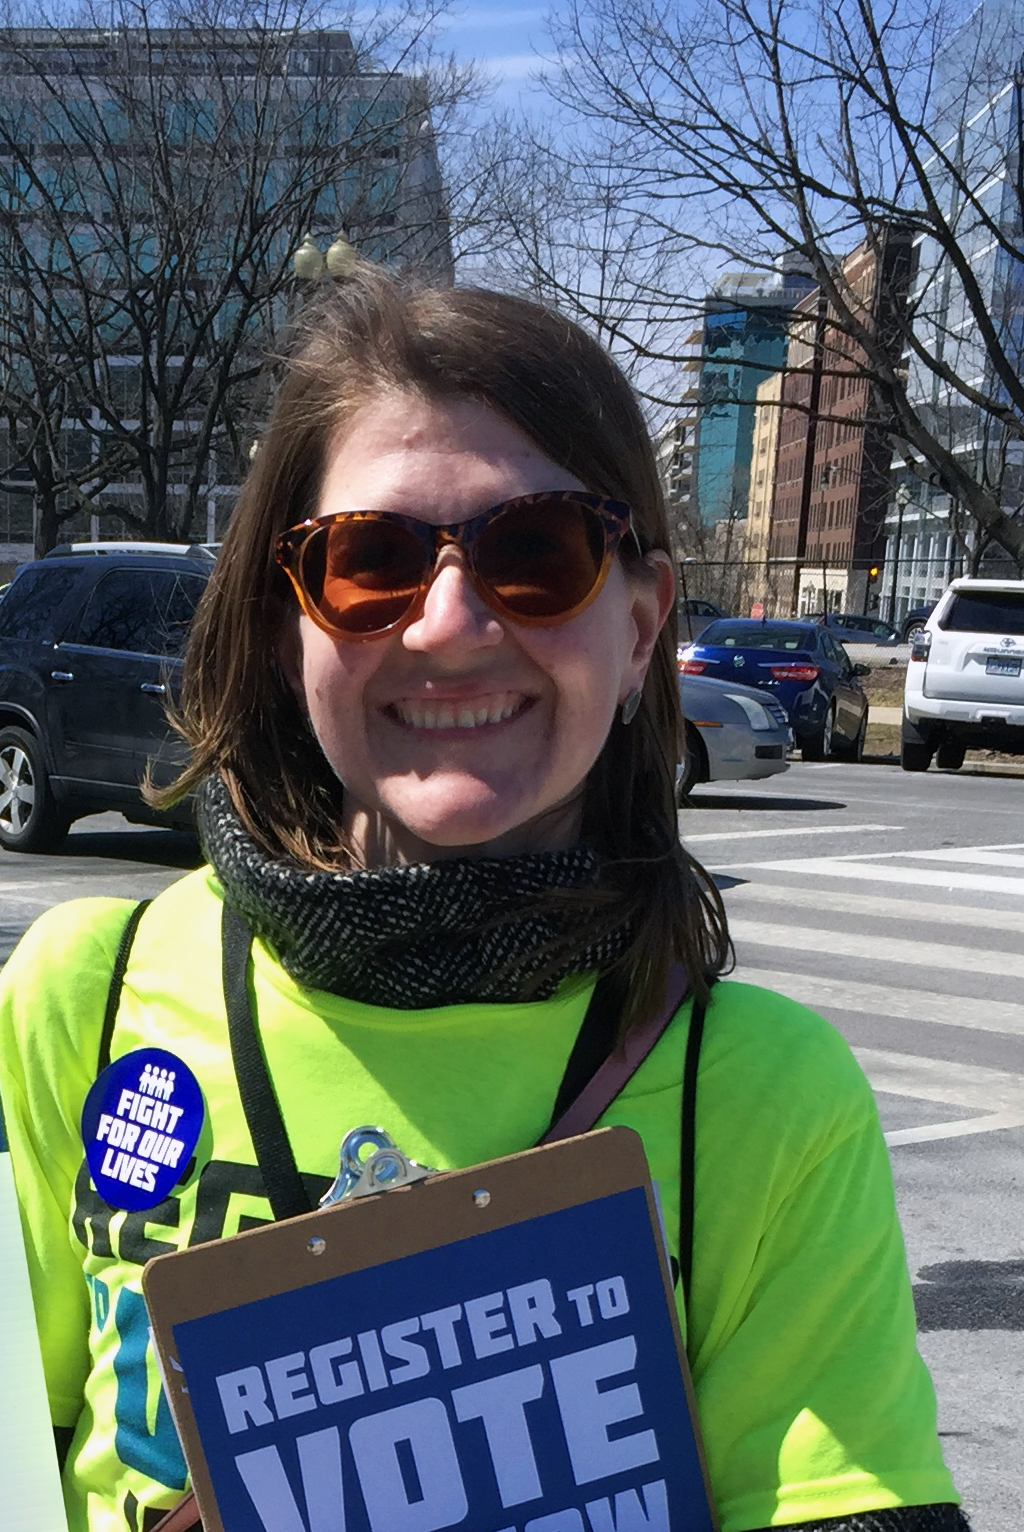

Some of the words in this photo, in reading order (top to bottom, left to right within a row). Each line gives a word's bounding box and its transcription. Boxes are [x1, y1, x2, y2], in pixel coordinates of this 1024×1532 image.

[116, 1089, 184, 1134] FIGHT
[96, 1113, 140, 1152] FOR
[137, 1130, 185, 1168] OUR
[100, 1148, 159, 1193] LIVES
[215, 1278, 562, 1435] REGISTER
[567, 1275, 630, 1327] TO
